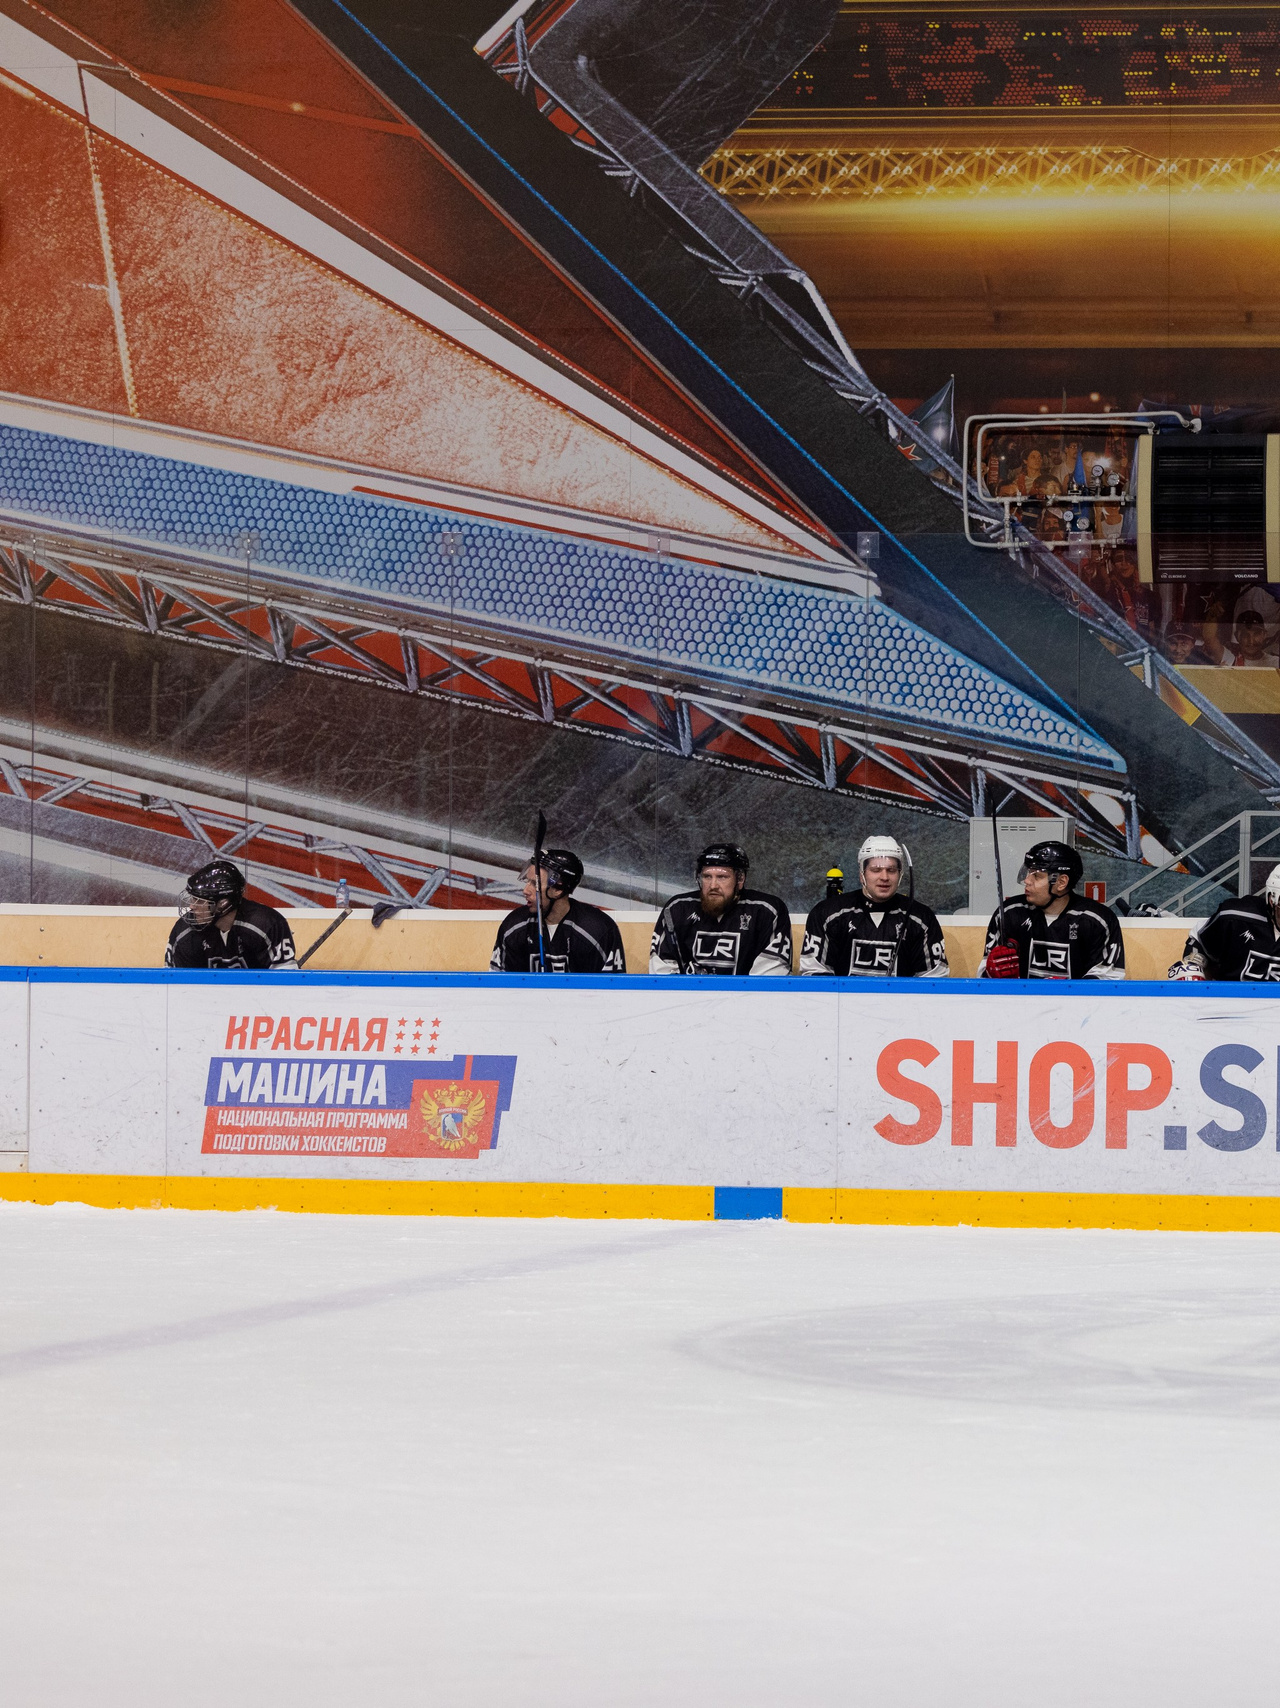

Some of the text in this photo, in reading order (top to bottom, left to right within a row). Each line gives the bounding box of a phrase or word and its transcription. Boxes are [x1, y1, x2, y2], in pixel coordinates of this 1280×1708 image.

[695, 938, 735, 958] LR
[765, 932, 791, 959] 22
[854, 946, 892, 967] LR
[1032, 949, 1067, 970] LR
[225, 1015, 388, 1052] КРАСНАЯ
[217, 1062, 387, 1105] МАШИНА
[217, 1110, 408, 1130] НАЦИОНАЛЬНАЯ ПРОГРАММА
[213, 1134, 387, 1153] ПОДГОТОВКИ ХОККЕИСТОВ
